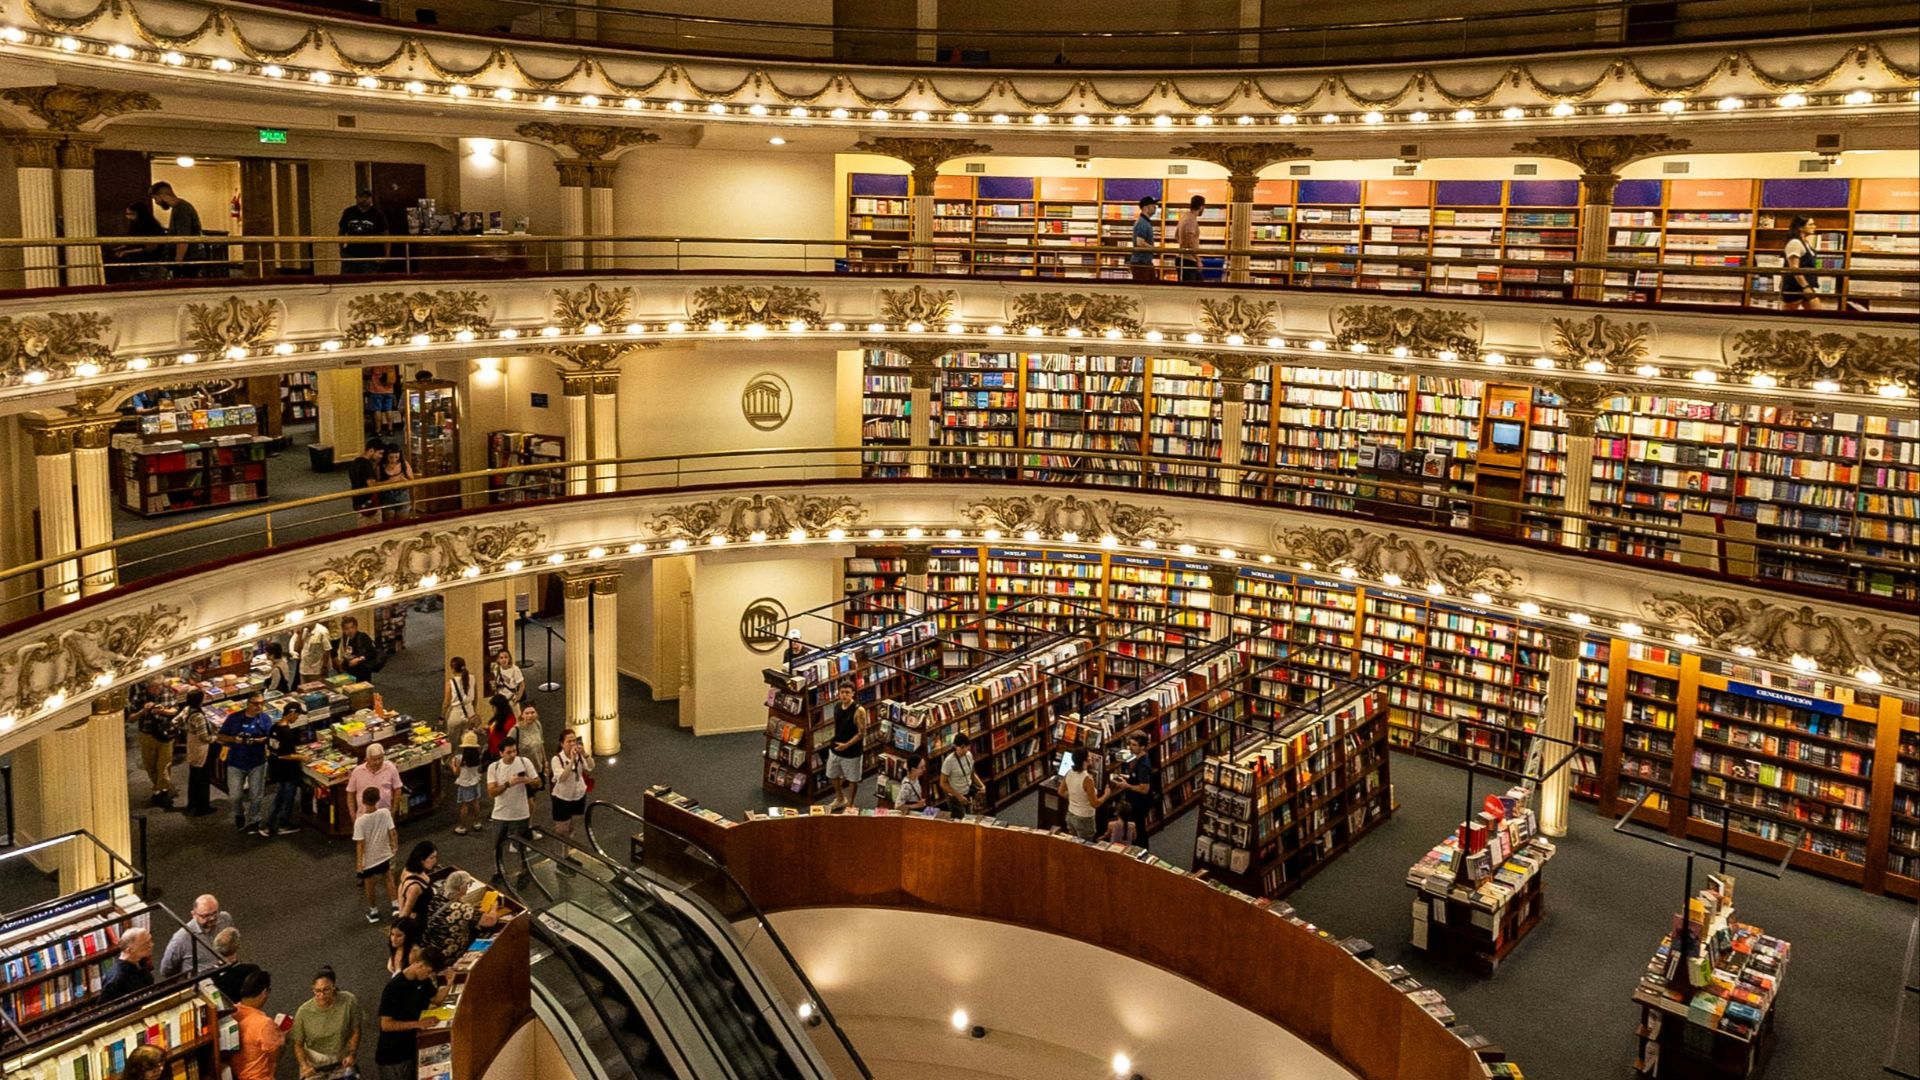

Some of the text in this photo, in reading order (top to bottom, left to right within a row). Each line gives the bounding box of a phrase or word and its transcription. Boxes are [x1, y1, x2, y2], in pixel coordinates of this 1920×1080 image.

[1250, 571, 1275, 579] NOVELAS
[1314, 580, 1339, 588] NOVELAS
[1756, 689, 1784, 699] CIENCIA
